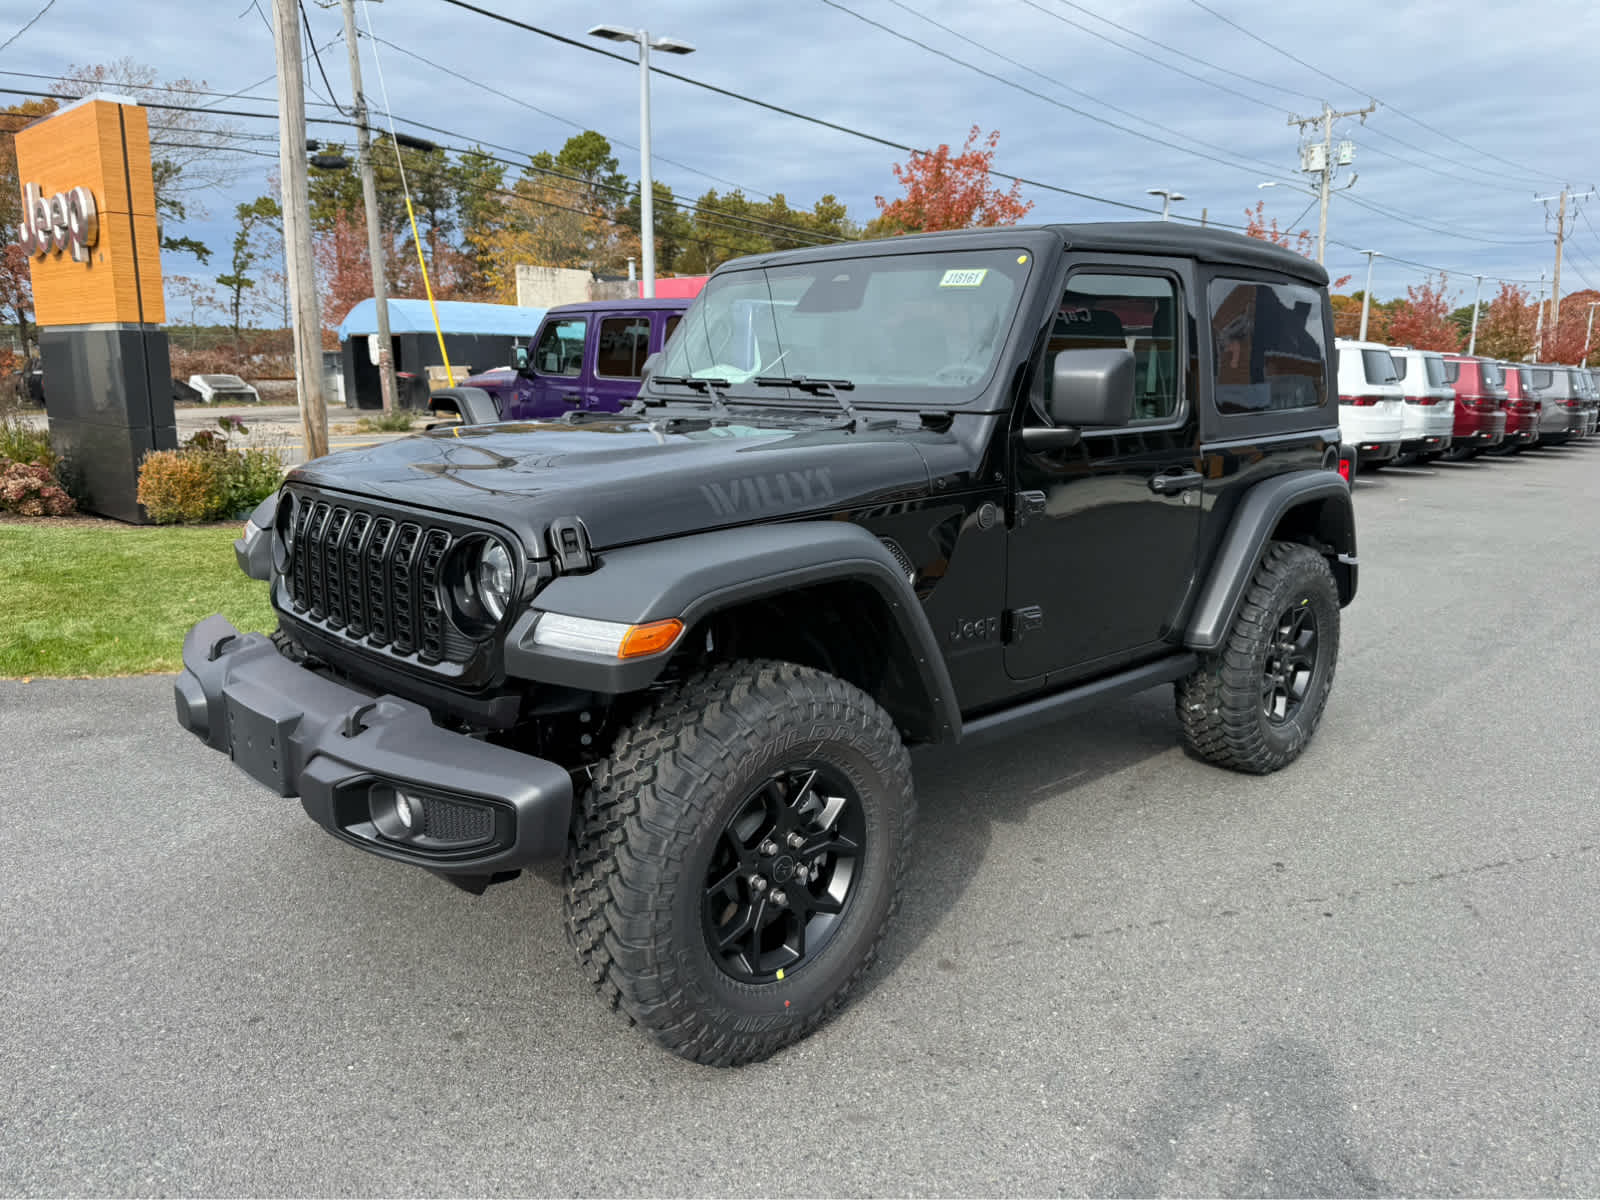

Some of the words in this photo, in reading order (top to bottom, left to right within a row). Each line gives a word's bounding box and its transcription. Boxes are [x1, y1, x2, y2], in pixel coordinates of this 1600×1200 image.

[18, 181, 97, 262] Jeep
[700, 465, 835, 517] WILLYS
[950, 617, 998, 641] Jeep
